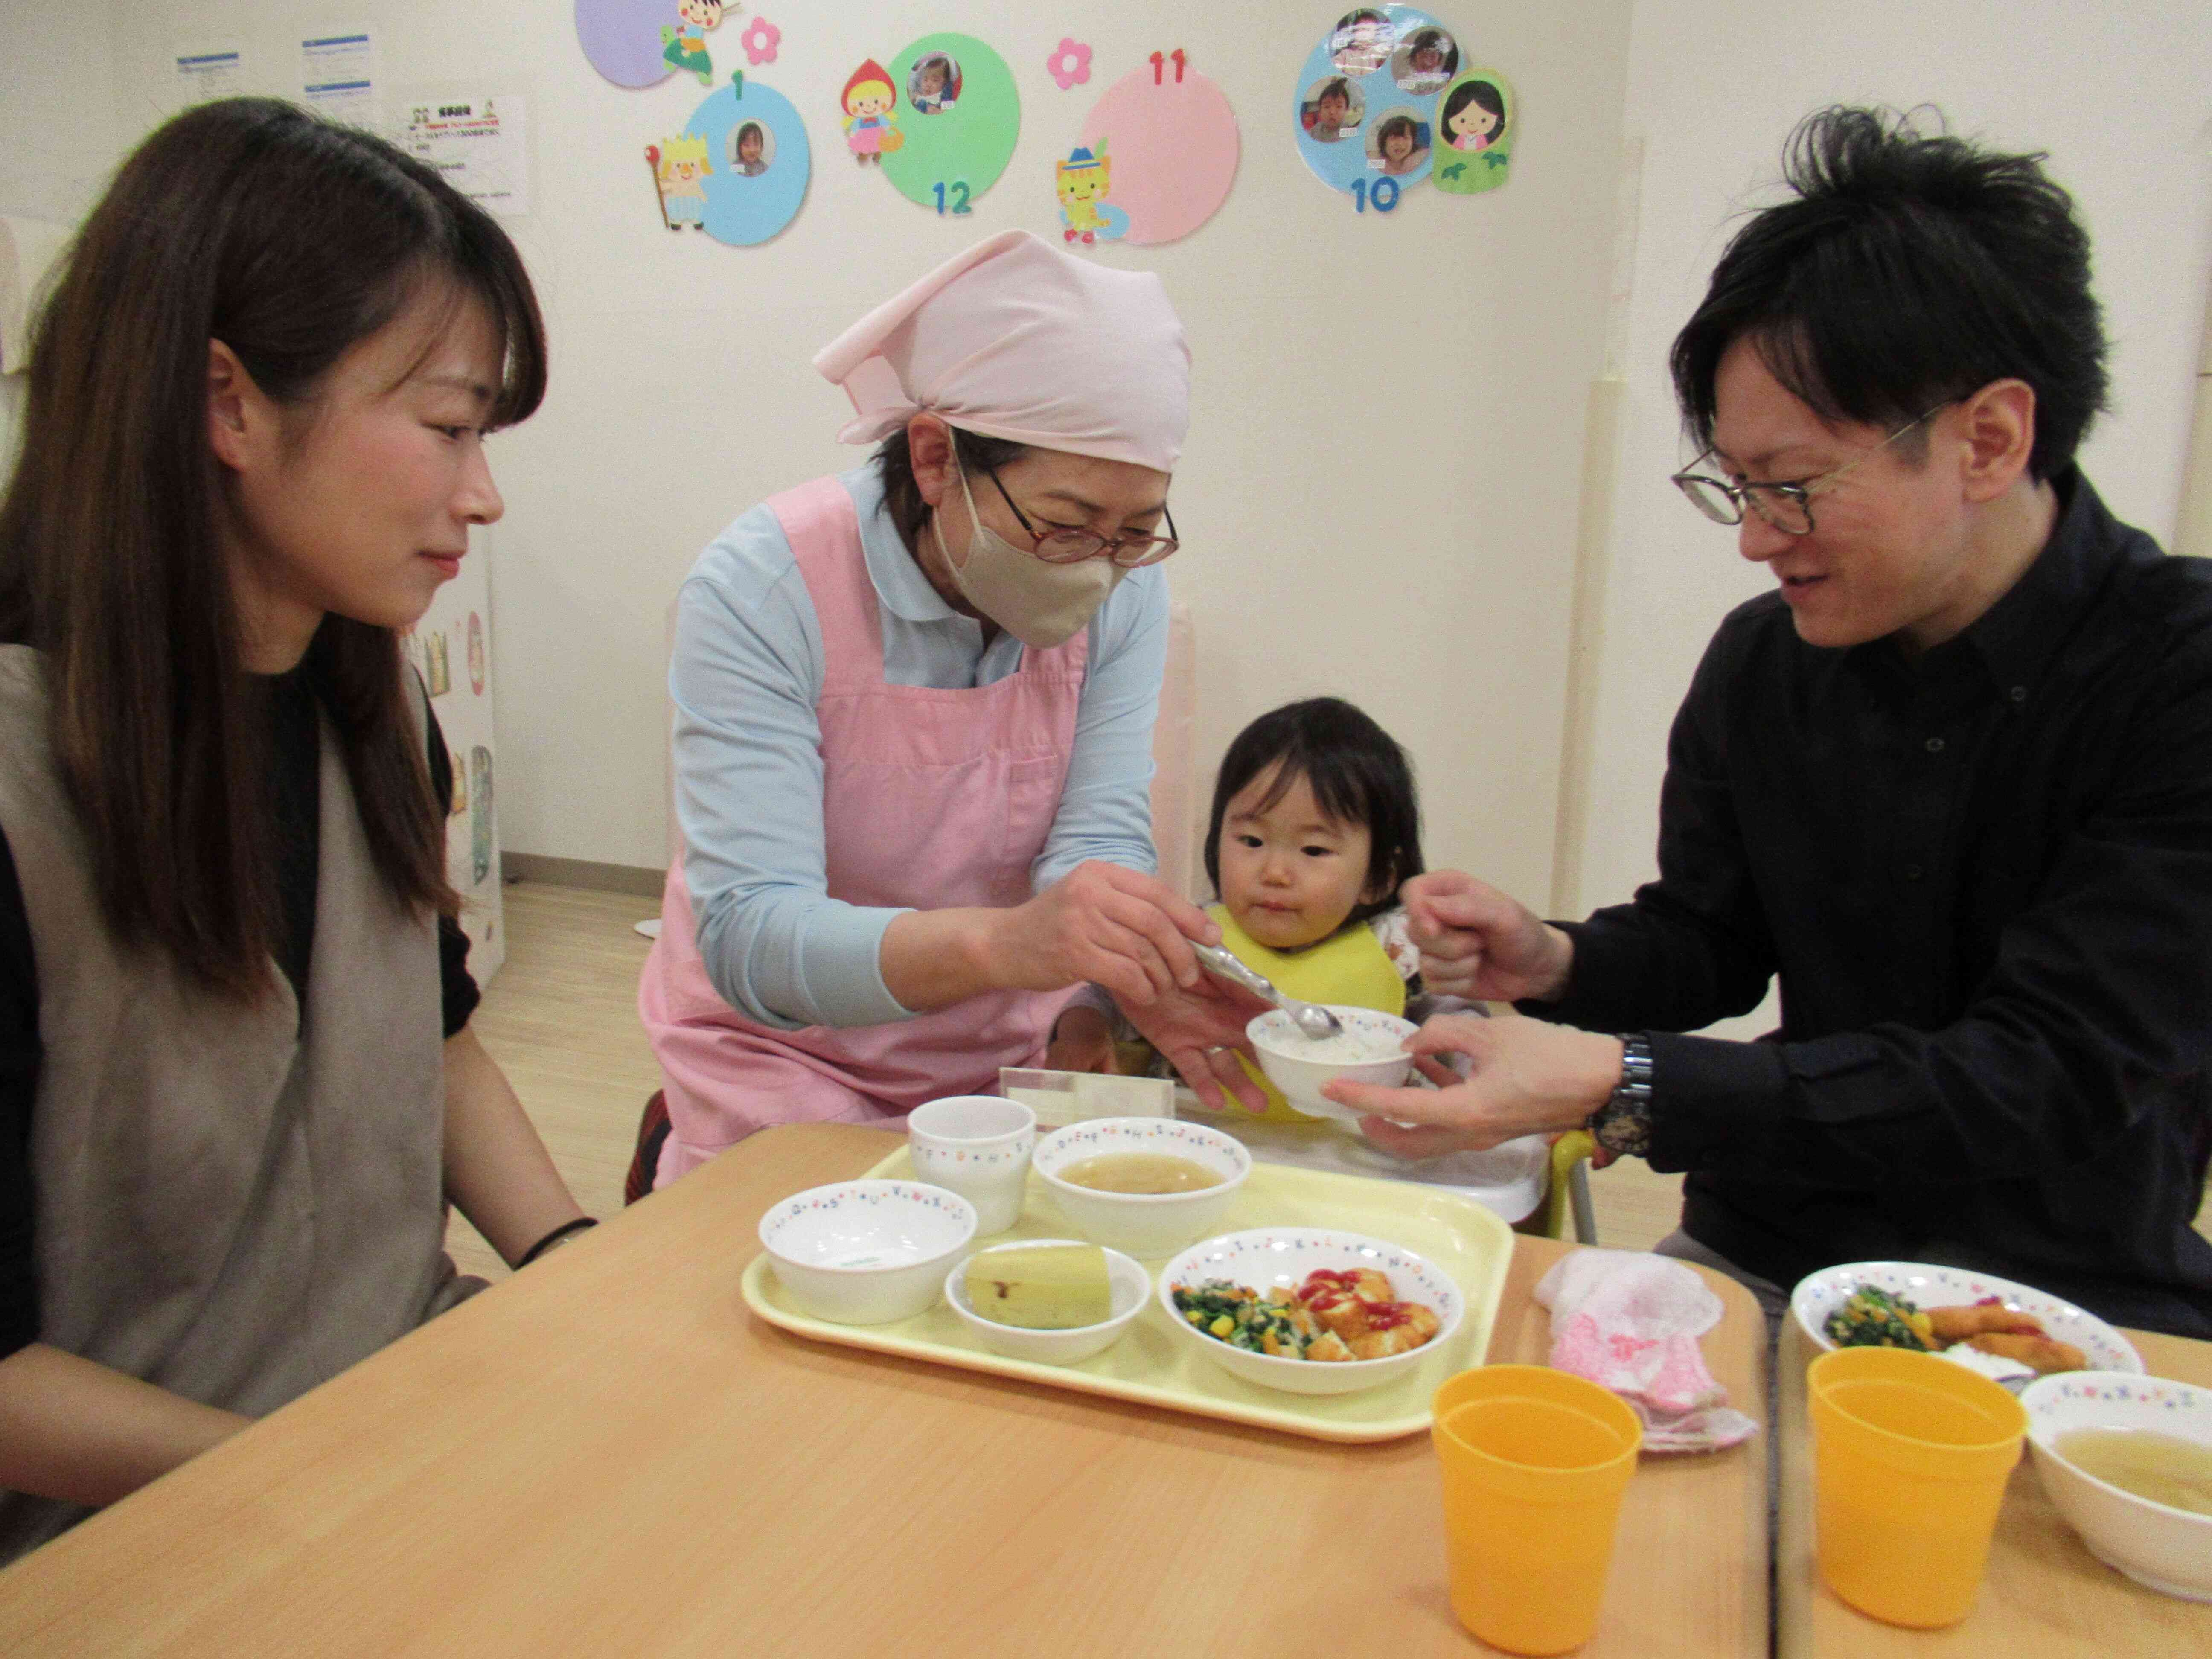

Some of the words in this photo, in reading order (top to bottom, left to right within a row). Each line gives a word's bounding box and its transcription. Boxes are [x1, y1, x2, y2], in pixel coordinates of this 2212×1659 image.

[1150, 49, 1185, 85] 11
[732, 70, 743, 101] 1
[933, 181, 972, 215] 12
[1350, 176, 1399, 211] 10
